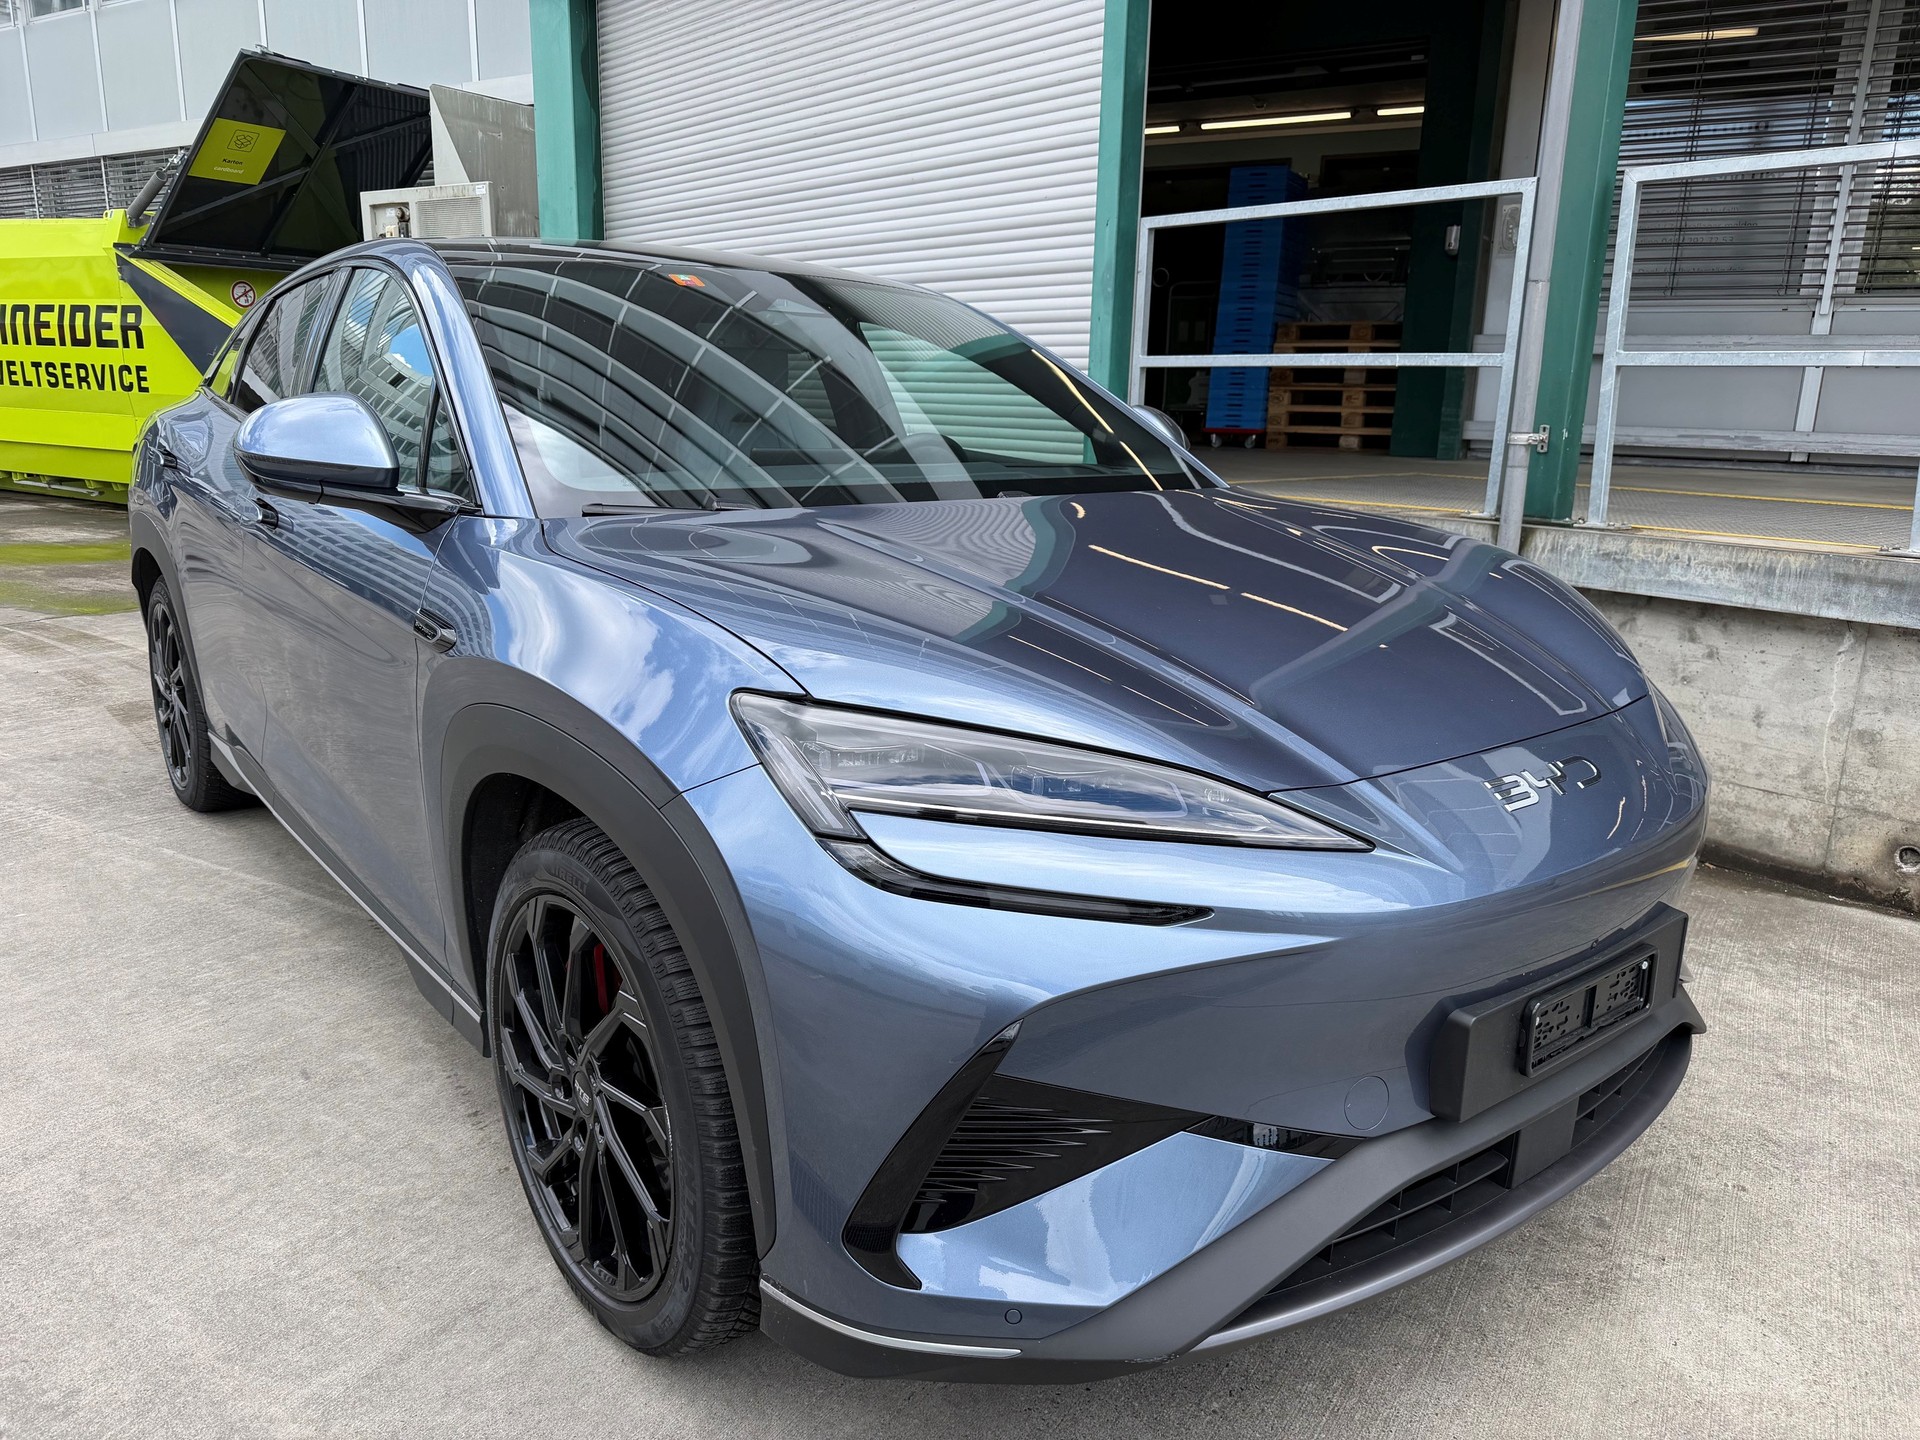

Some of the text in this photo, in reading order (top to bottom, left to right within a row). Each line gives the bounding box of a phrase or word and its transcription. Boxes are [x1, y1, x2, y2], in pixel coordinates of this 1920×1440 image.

[213, 166, 244, 175] cardboard
[222, 158, 243, 166] Karton
[0, 360, 150, 393] ELTSERVICE
[1482, 754, 1602, 813] BYD
